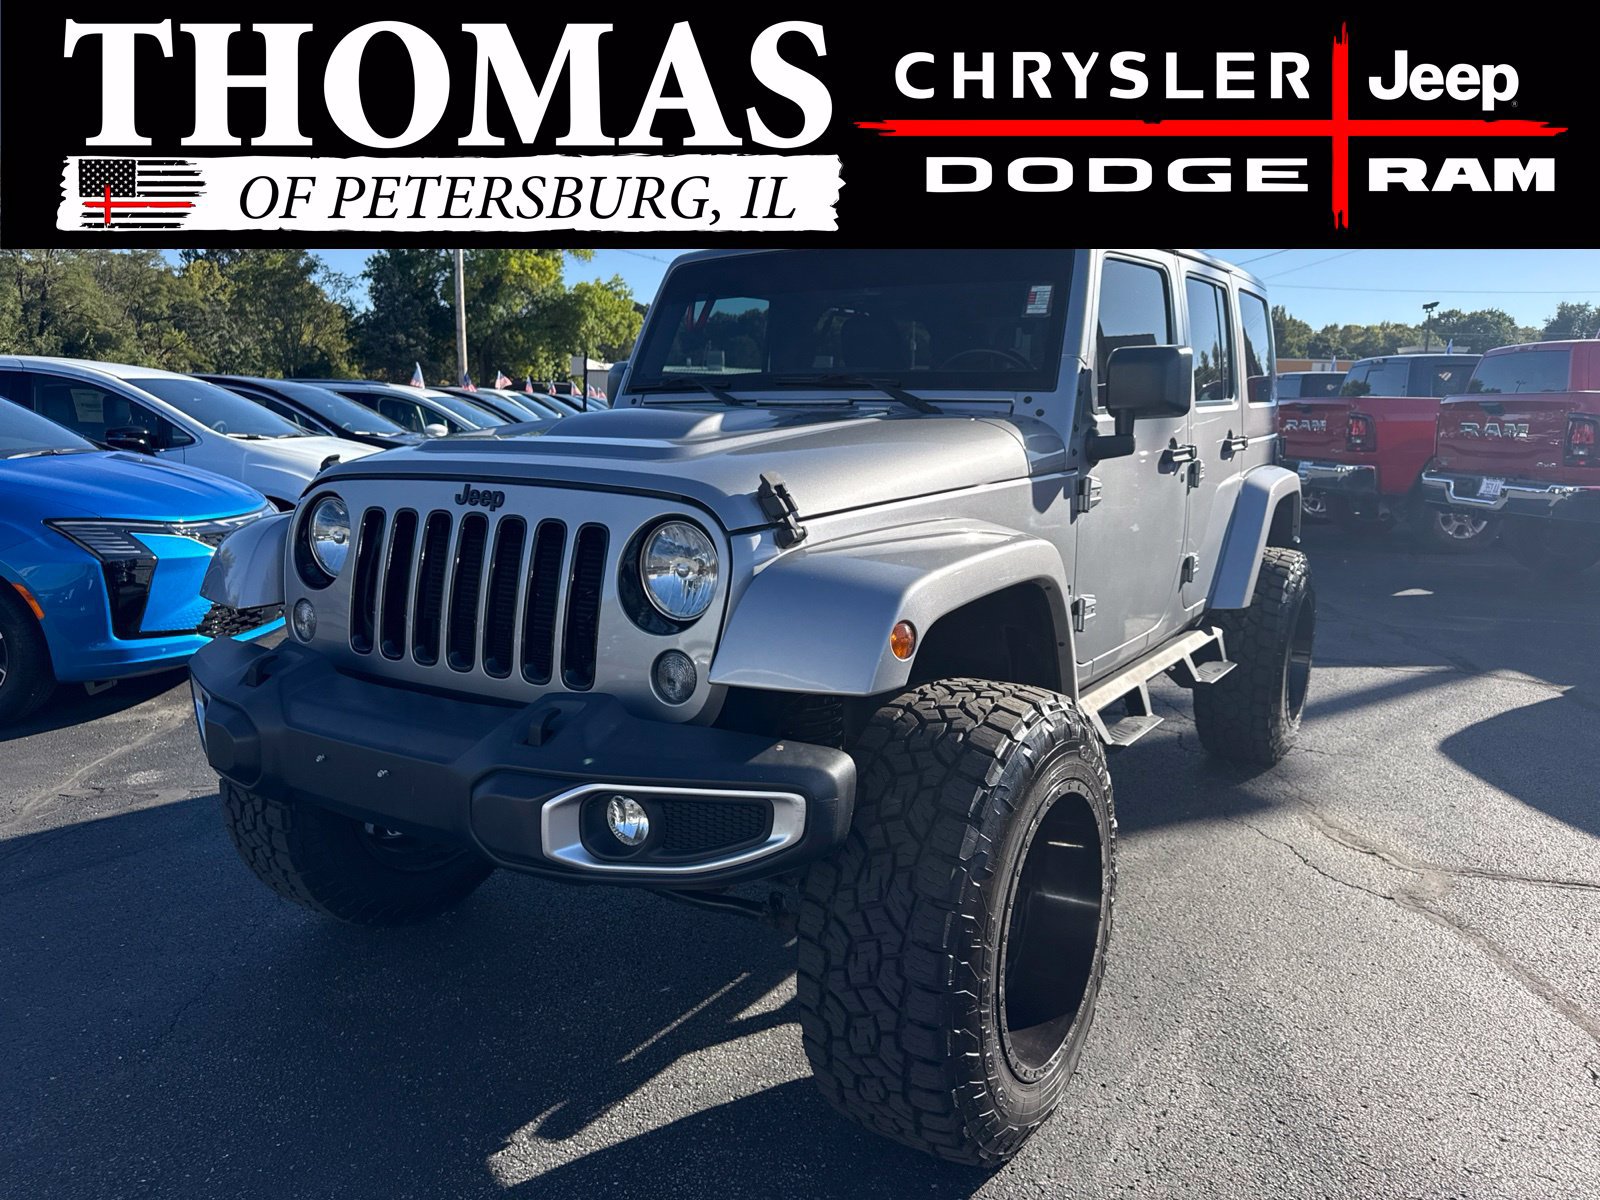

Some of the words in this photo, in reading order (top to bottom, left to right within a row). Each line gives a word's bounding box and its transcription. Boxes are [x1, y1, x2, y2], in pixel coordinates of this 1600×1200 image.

[1283, 419, 1327, 431] RAM
[1460, 422, 1529, 438] RAM
[455, 484, 505, 512] Jeep
